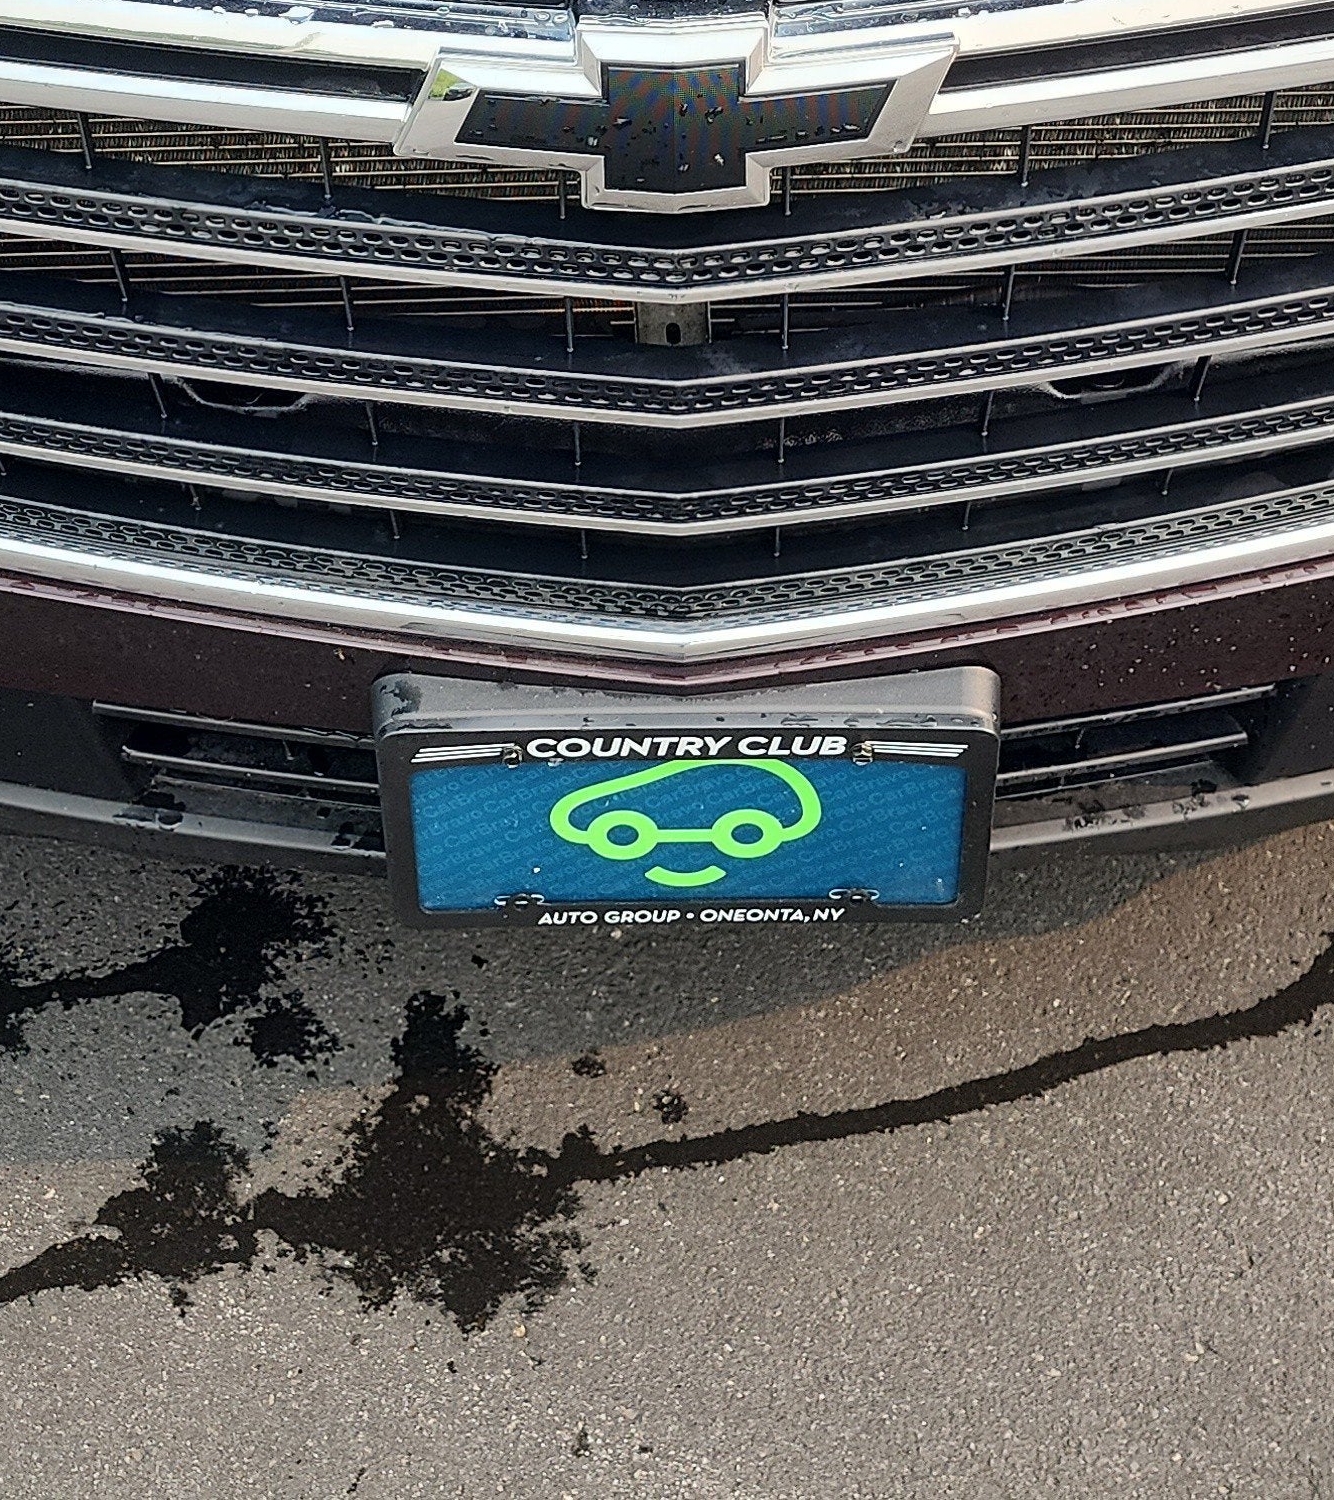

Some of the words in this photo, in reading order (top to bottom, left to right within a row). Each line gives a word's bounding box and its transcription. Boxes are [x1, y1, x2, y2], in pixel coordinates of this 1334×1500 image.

[525, 736, 733, 758] COUNTRY
[737, 735, 848, 757] CLUB
[538, 911, 598, 925] AUTO
[604, 910, 681, 924] GROUP
